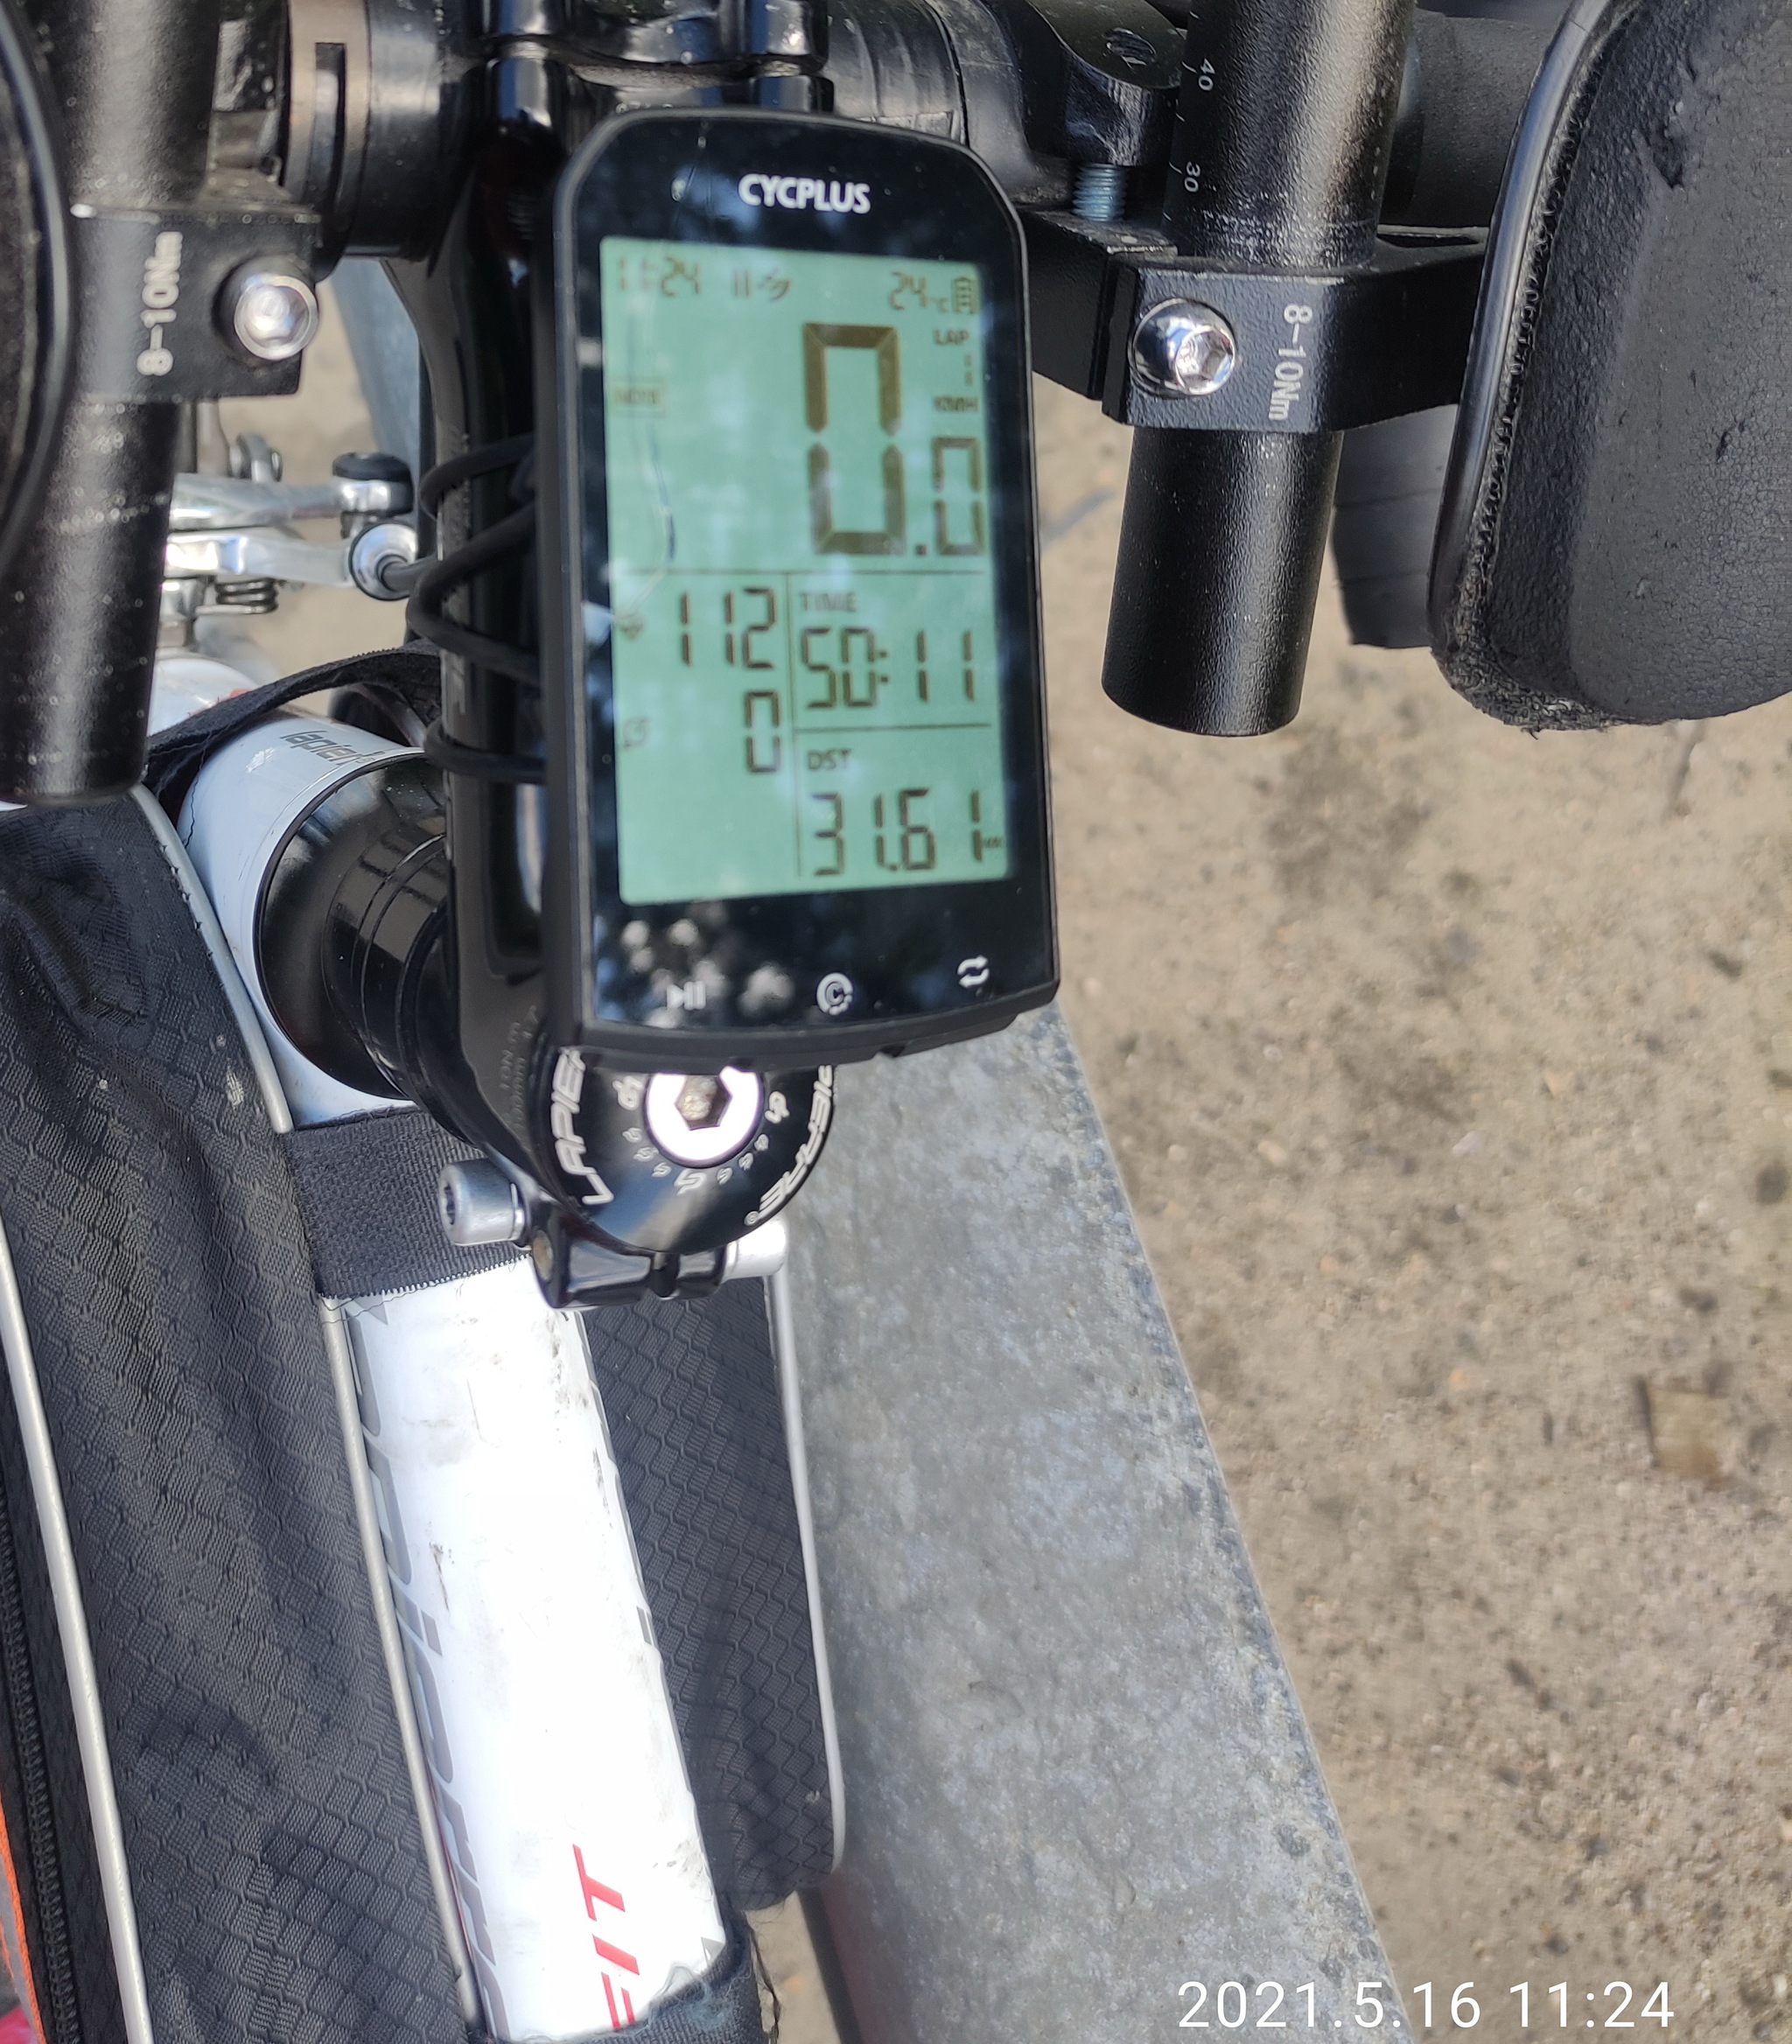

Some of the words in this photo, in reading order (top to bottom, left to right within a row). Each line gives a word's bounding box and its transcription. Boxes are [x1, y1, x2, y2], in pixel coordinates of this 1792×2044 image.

[1197, 57, 1215, 92] 40
[738, 172, 872, 214] CYCPLUS
[1183, 161, 1201, 193] 30
[933, 327, 970, 346] LAP
[1268, 303, 1313, 422] 8-10Nm
[802, 322, 986, 557] 0.0
[679, 586, 778, 670] 112
[798, 592, 858, 613] TIME
[800, 626, 976, 710] 50:11
[744, 690, 781, 774] 0
[807, 748, 852, 772] DST
[810, 788, 984, 877] 31.61
